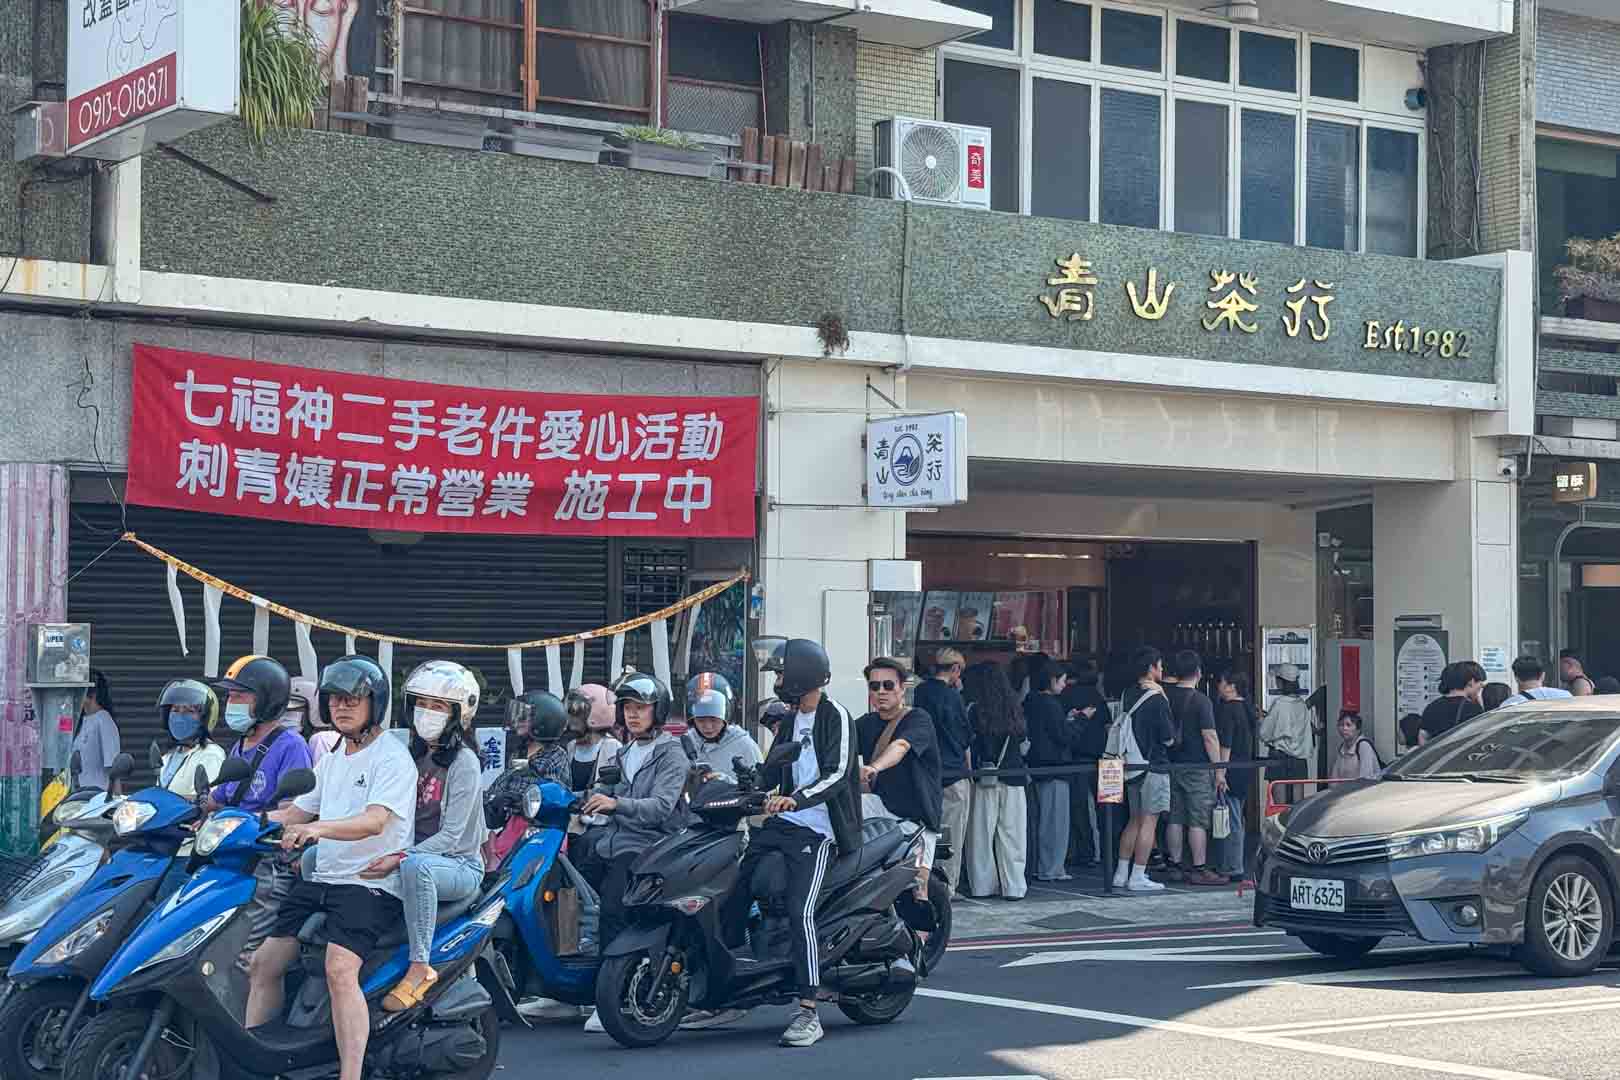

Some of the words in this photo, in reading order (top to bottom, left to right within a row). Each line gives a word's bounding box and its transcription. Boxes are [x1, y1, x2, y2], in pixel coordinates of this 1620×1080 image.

[79, 65, 168, 134] 0913-018871
[1040, 252, 1335, 341] 青山茶行
[174, 369, 725, 461] 七福神二手老件愛心活動
[554, 469, 713, 523] 施工中
[1292, 885, 1343, 906] ART-6325
